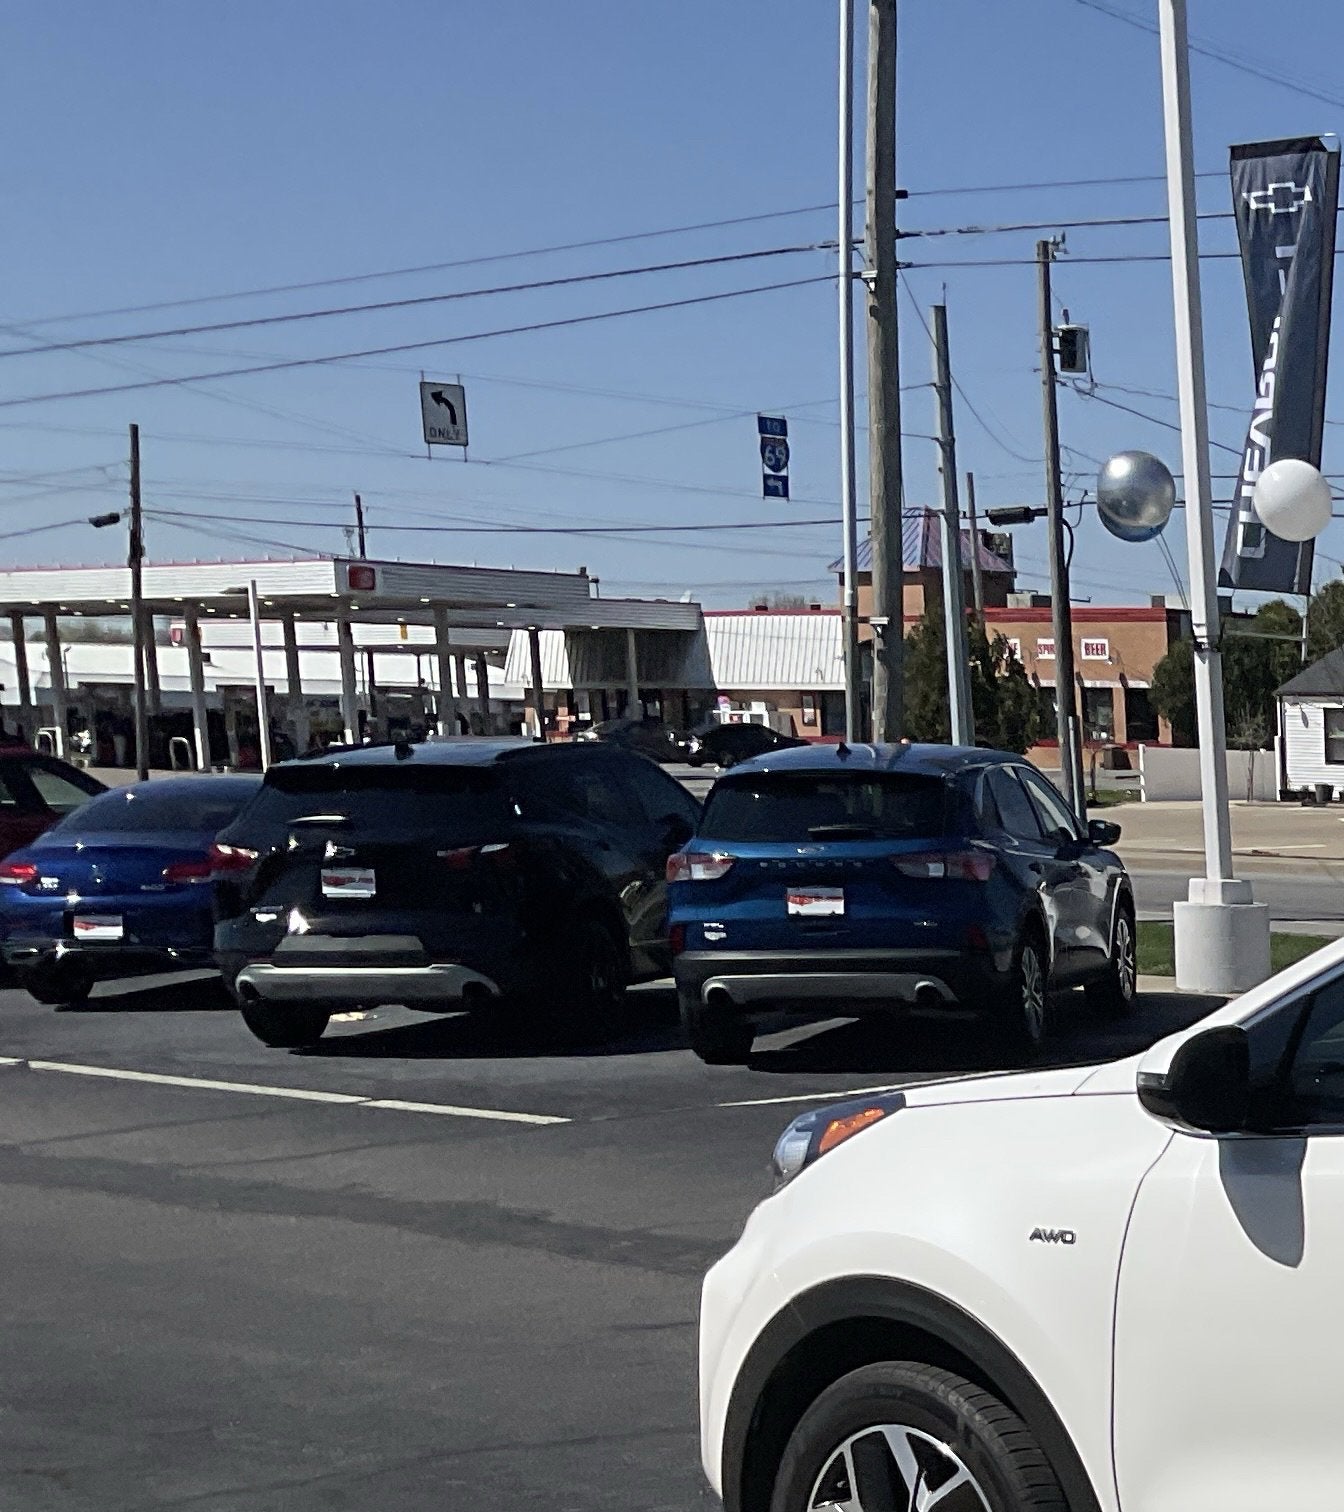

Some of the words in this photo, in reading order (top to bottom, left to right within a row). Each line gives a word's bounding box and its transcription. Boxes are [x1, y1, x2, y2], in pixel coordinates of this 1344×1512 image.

[429, 426, 460, 441] ONLY
[764, 446, 786, 466] 69
[1037, 643, 1054, 655] SPIR
[1083, 643, 1106, 656] BEER
[1029, 1227, 1076, 1244] AWD
